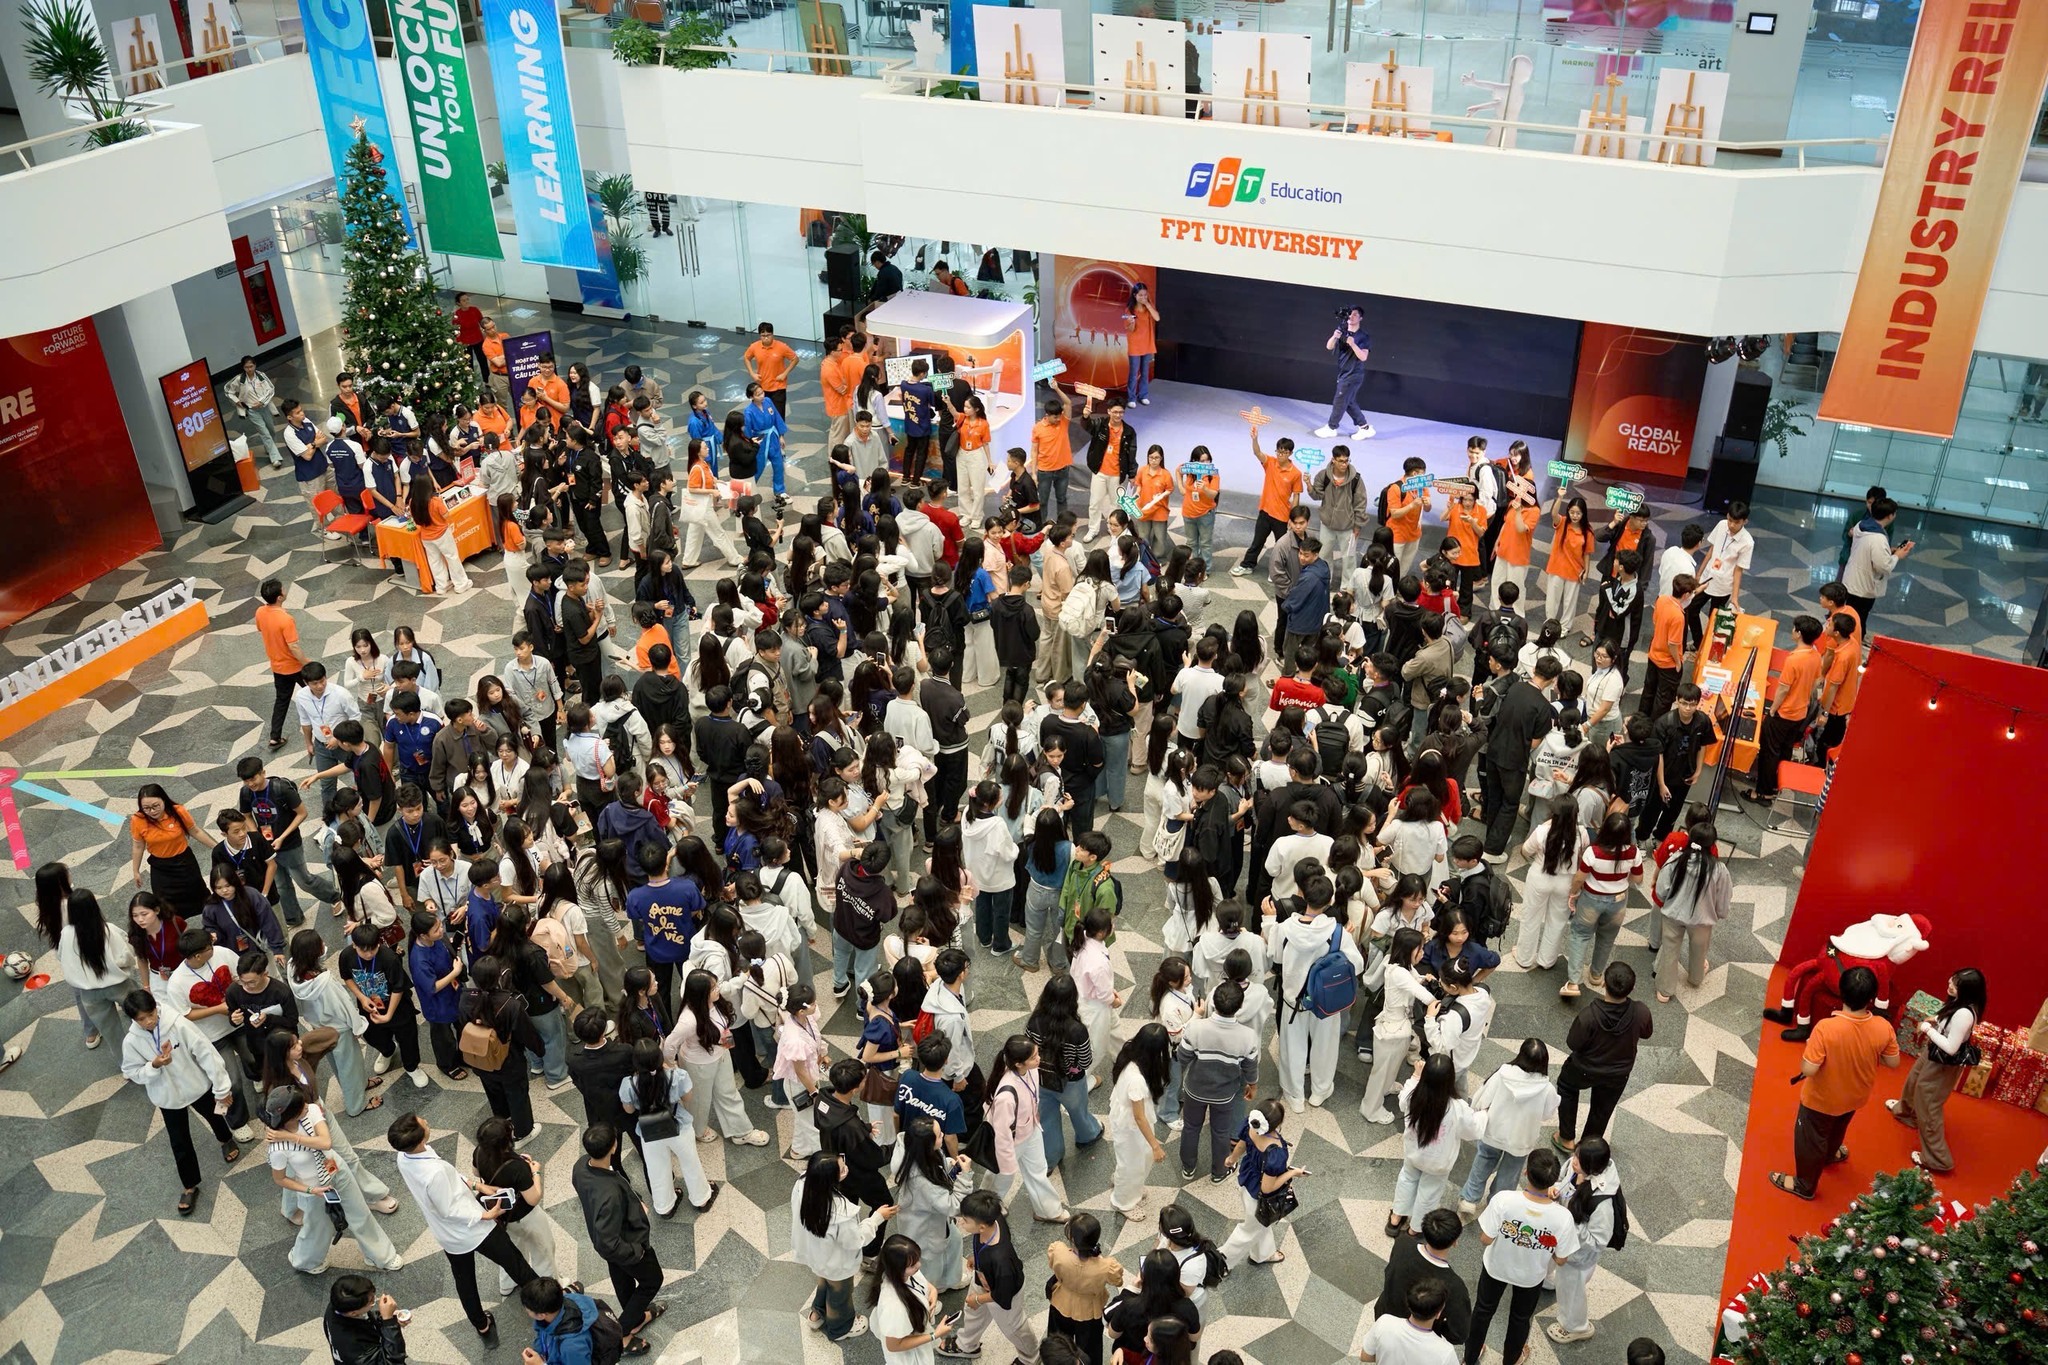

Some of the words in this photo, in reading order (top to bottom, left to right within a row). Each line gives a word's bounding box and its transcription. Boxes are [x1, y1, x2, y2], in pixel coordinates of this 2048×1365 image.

[1699, 59, 1722, 70] art
[438, 66, 464, 135] YOUR
[510, 8, 566, 225] LEARNING
[1188, 166, 1262, 199] FPT
[1271, 182, 1342, 204] Education
[1160, 218, 1206, 242] FPT
[1212, 224, 1363, 261] UNIVERSITY
[1876, 107, 1986, 381] INDUSTRY
[52, 324, 84, 342] FUTURE
[43, 333, 86, 356] FORWARD
[1618, 423, 1682, 443] GLOBAL
[1628, 438, 1680, 456] READY
[1551, 468, 1574, 478] TRUNG
[649, 902, 683, 919] Acme
[664, 930, 685, 945] vie
